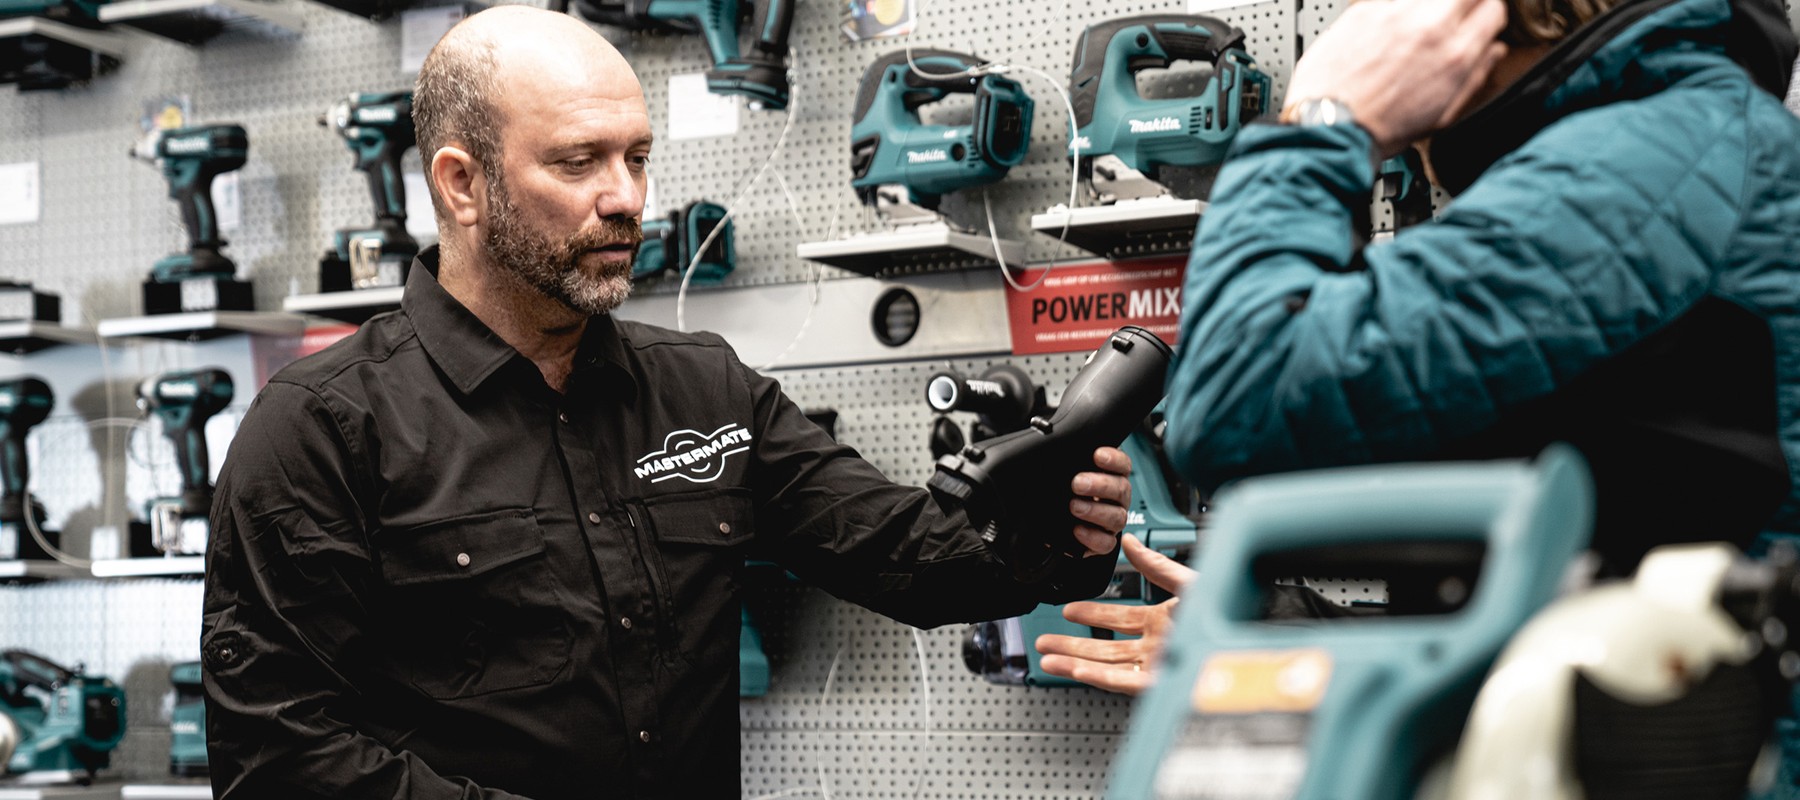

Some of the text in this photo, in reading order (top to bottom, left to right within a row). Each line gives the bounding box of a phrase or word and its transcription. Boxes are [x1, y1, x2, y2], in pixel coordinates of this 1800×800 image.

[1129, 117, 1181, 133] Makita
[907, 149, 947, 163] Makita
[1032, 286, 1180, 325] POWERMIX
[634, 428, 752, 479] MASTERMATE
